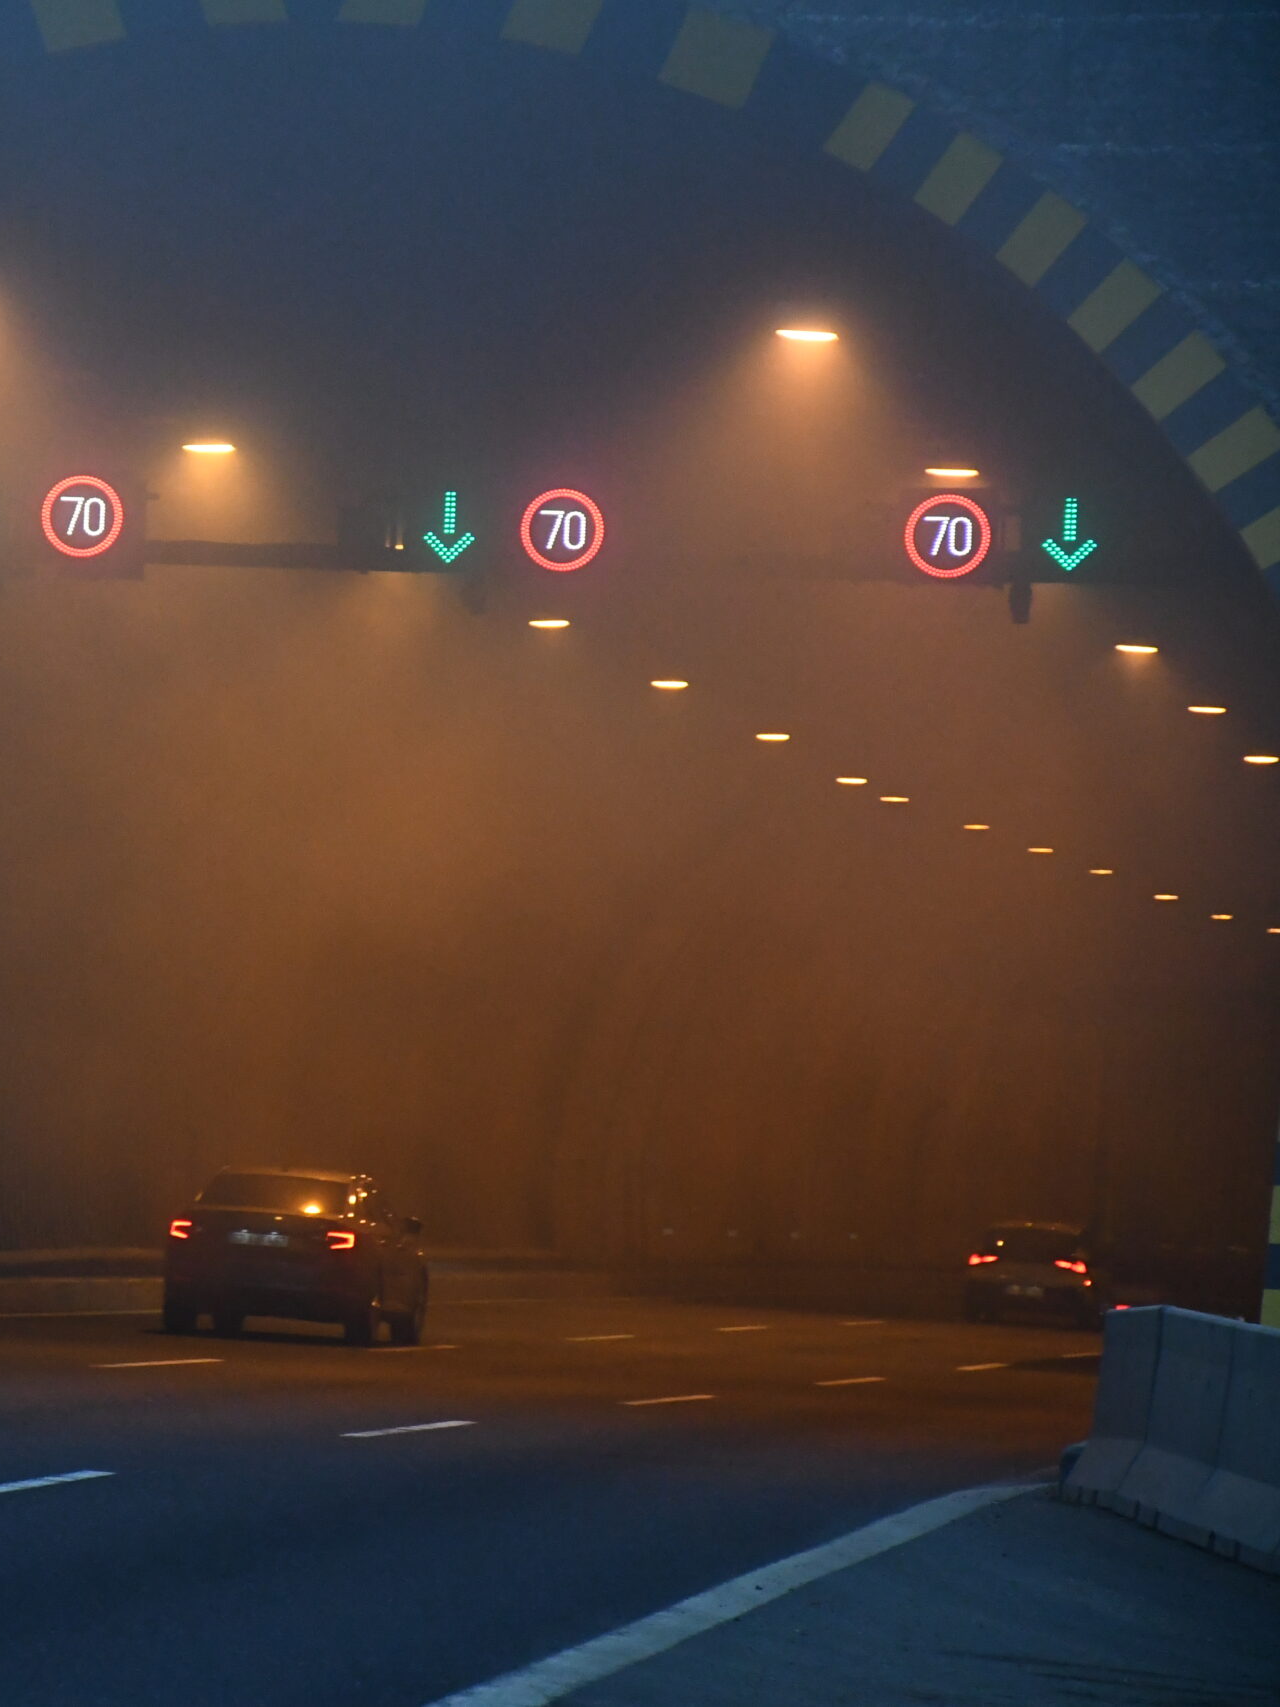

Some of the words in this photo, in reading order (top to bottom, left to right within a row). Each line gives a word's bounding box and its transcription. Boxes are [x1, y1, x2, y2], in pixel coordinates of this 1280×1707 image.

[60, 496, 106, 536] 70
[539, 509, 587, 550] 70
[923, 516, 971, 556] 70
